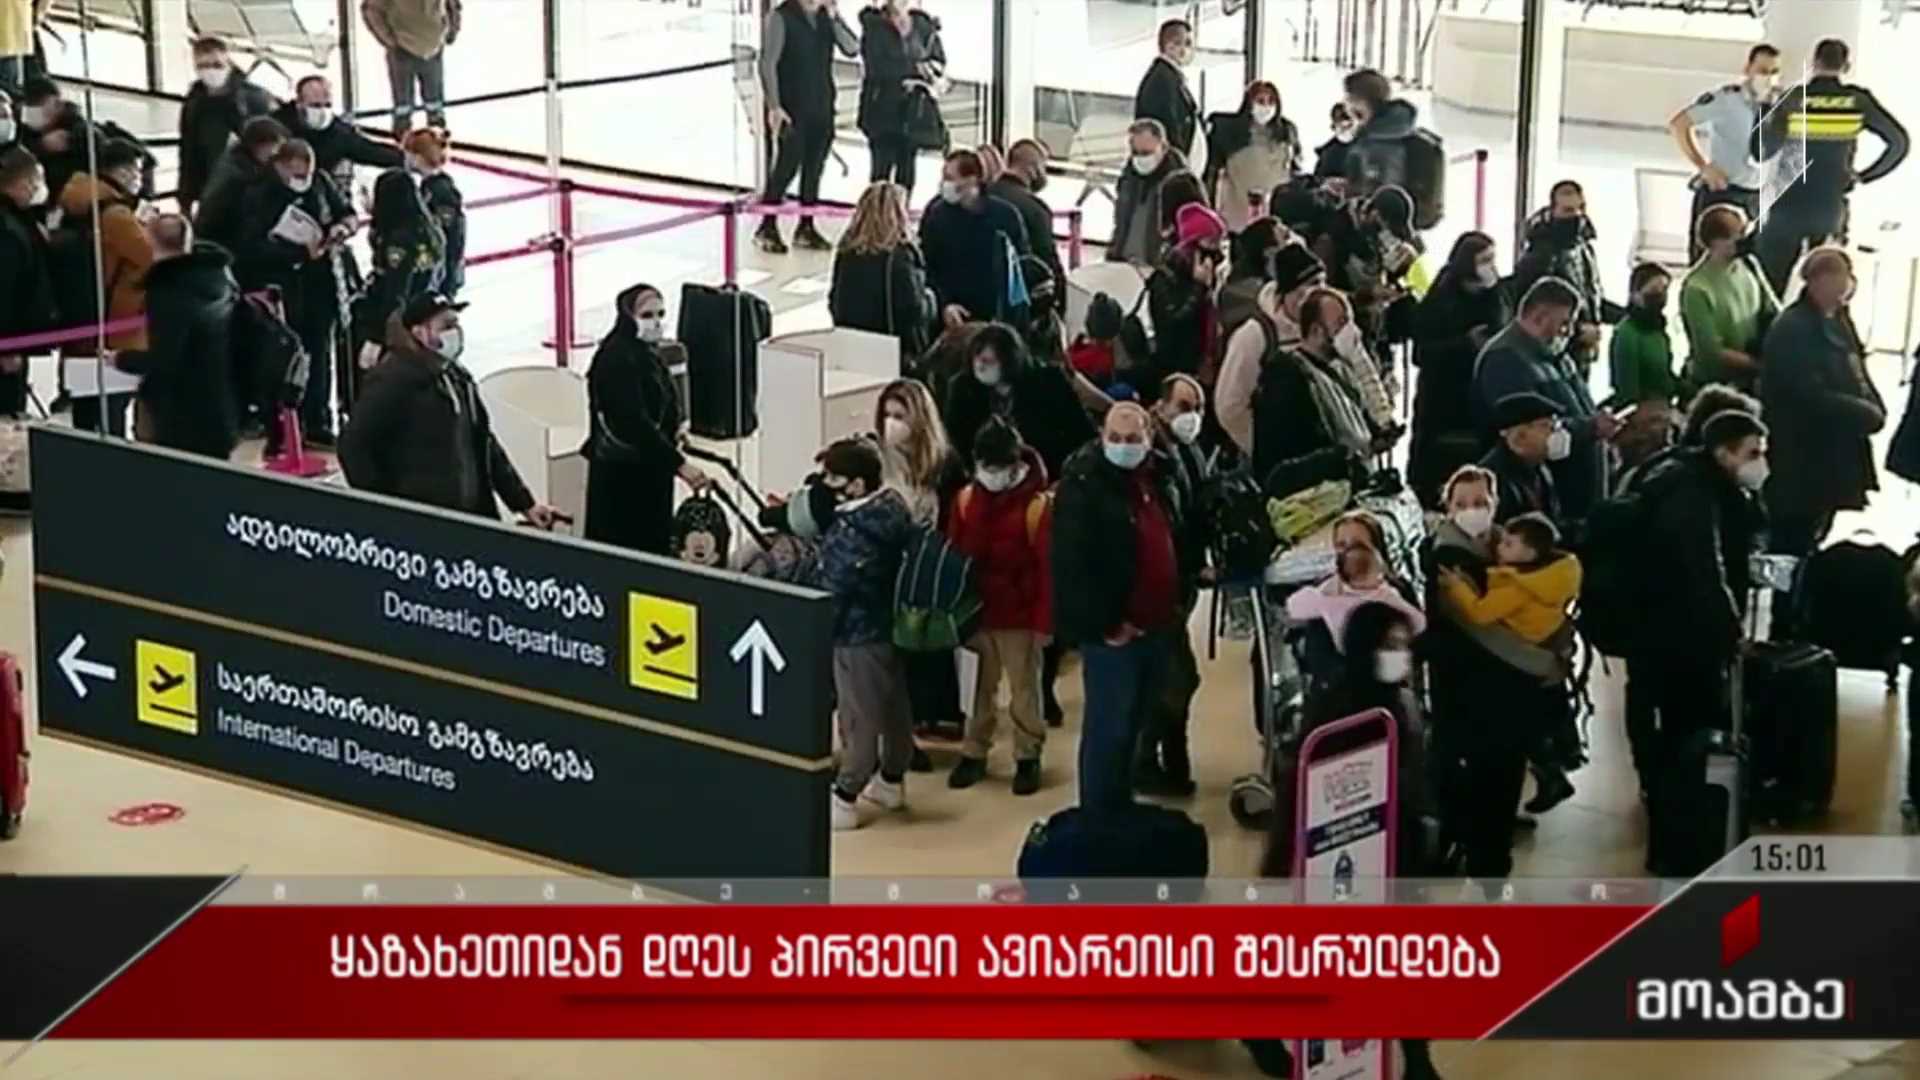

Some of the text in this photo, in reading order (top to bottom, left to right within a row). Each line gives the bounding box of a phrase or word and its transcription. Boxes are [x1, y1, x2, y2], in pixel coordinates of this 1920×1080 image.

[226, 513, 605, 619] ადგილობრივი გამგზავრება
[383, 590, 605, 667] Domestic Departures
[216, 662, 594, 781] საერთაშორისო გამგზავრება
[217, 707, 456, 790] International Departures
